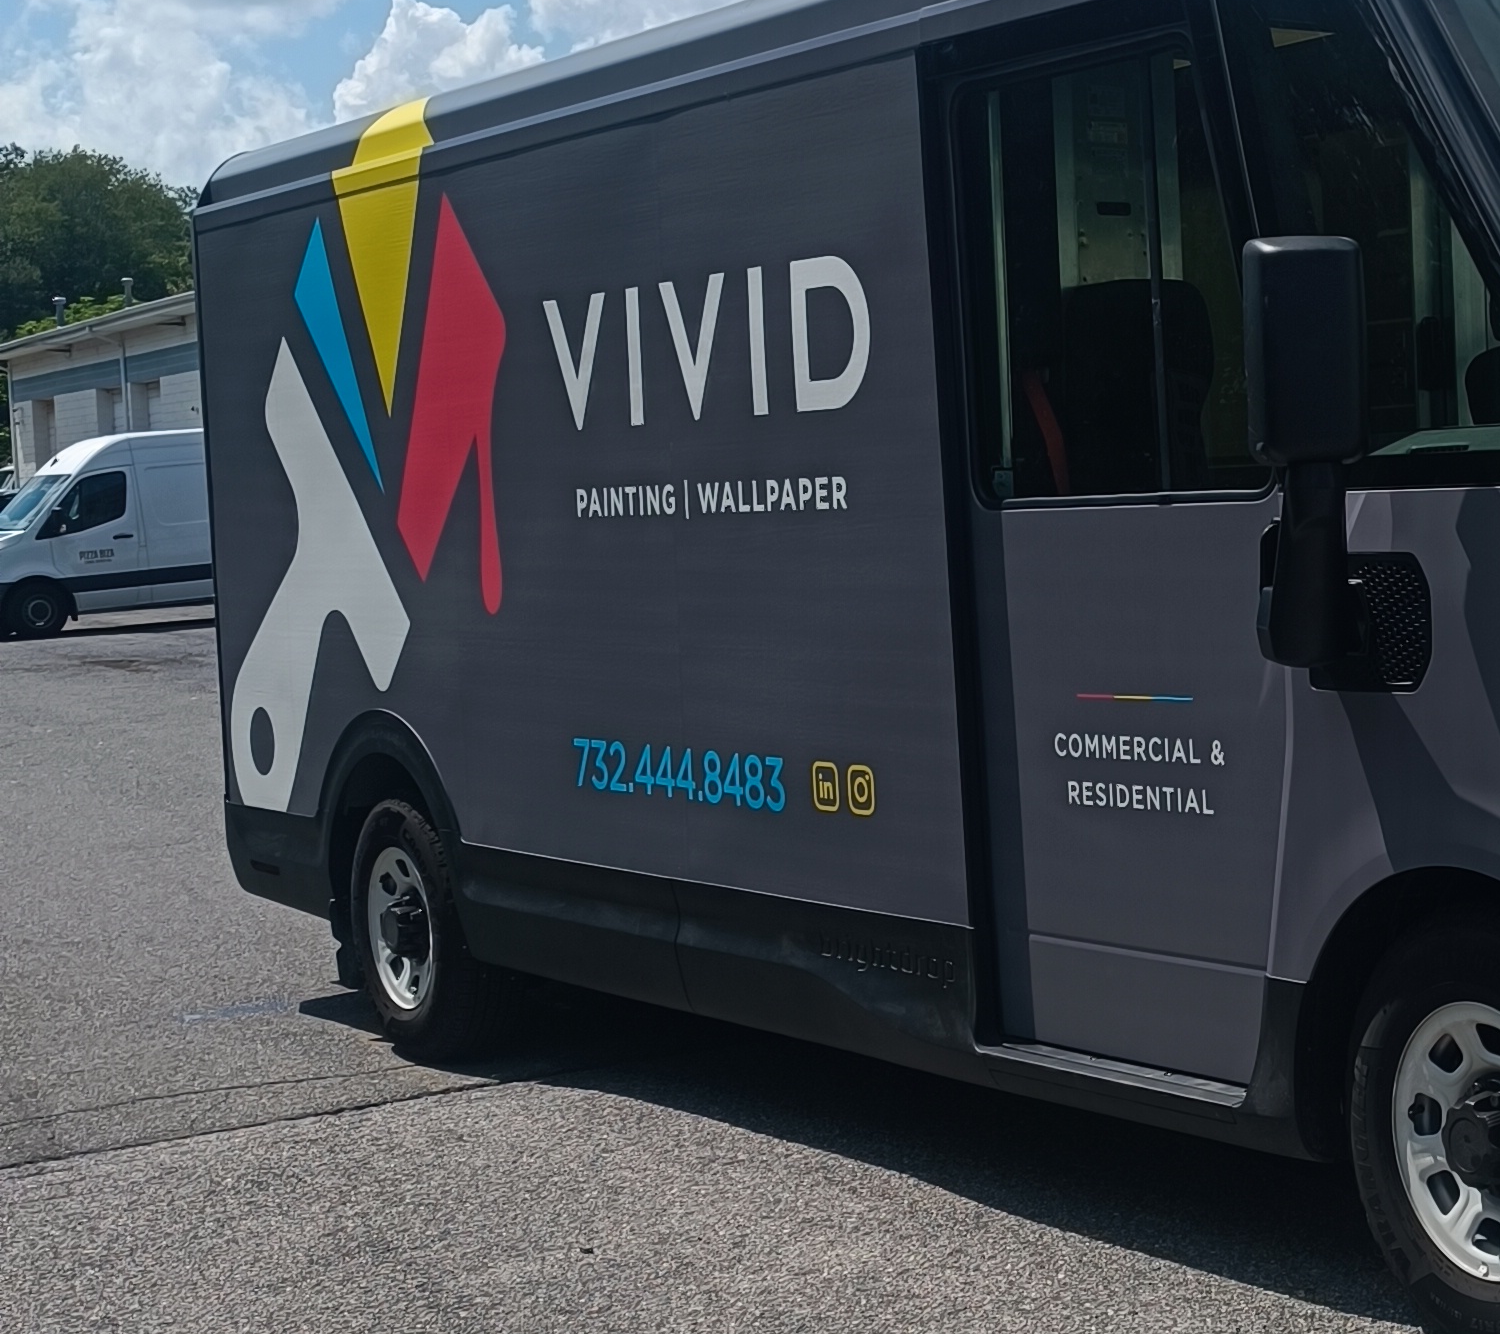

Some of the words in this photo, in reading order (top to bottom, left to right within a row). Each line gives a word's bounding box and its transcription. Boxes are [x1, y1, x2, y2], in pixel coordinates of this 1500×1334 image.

[543, 255, 871, 431] VIVID
[575, 484, 676, 518] PAINTING
[697, 476, 848, 514] WALLPAPER
[1054, 732, 1201, 764] COMMERCIAL
[1210, 740, 1225, 766] &
[573, 738, 786, 812] 732.444.8483
[1067, 780, 1215, 815] RESIDENTIAL
